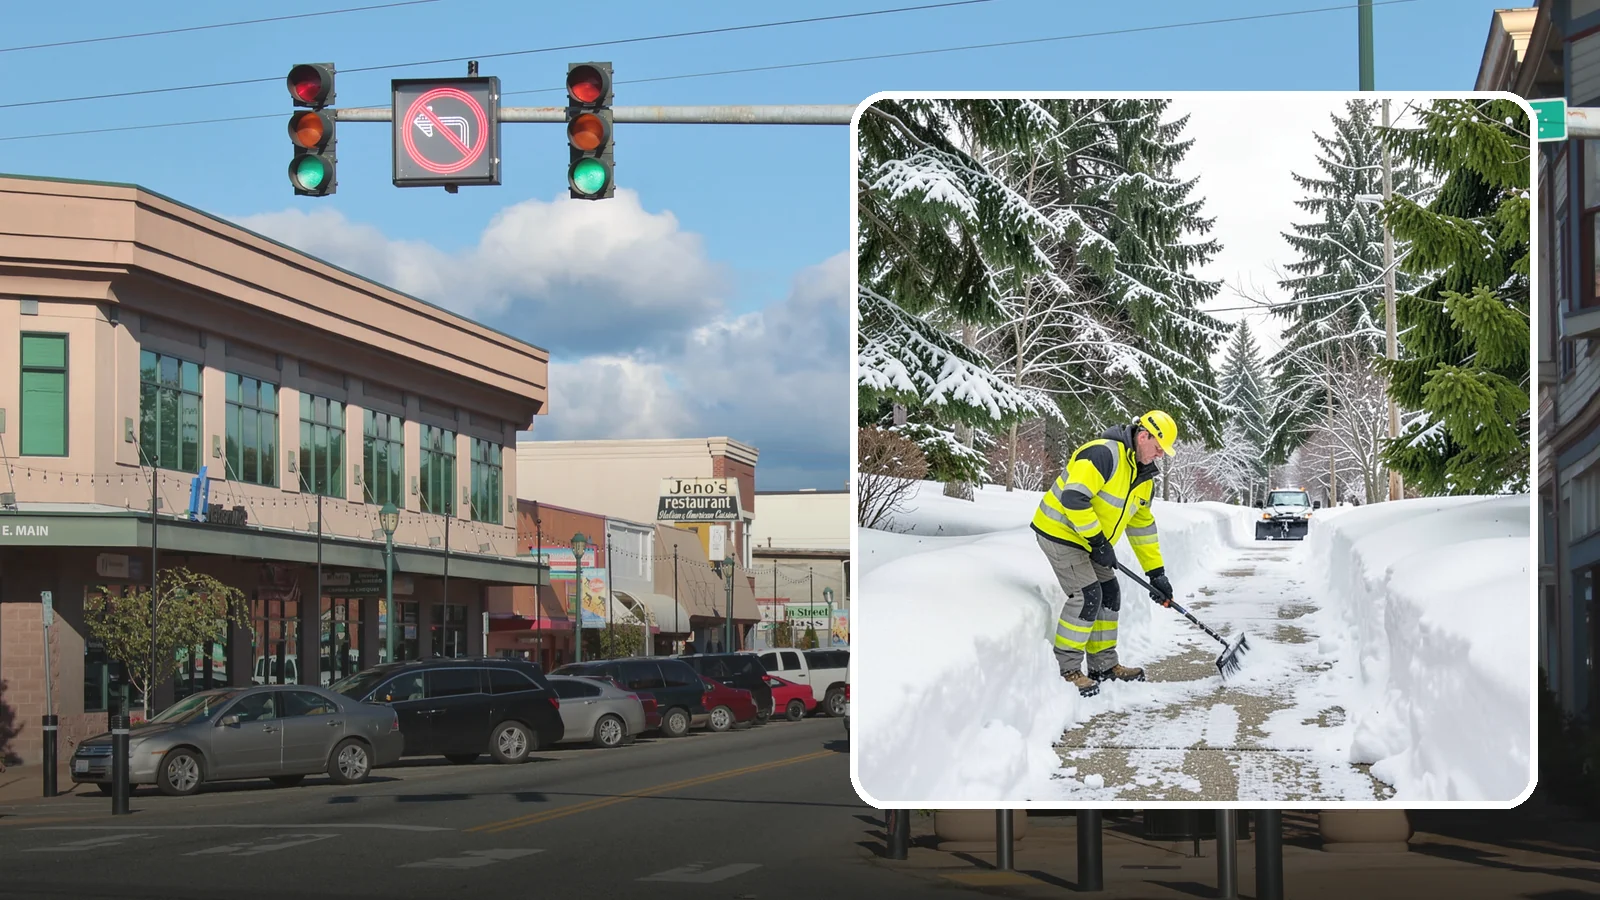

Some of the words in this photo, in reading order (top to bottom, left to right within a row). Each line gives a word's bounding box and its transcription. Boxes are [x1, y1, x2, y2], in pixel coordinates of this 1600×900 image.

[669, 480, 727, 494] Jeno's
[665, 496, 731, 509] restaurant
[658, 509, 681, 519] Italian
[686, 509, 714, 519] American
[715, 509, 738, 519] Cuisine
[2, 525, 13, 536] E.
[15, 525, 49, 536] MAIN
[797, 607, 829, 616] Street
[791, 619, 824, 627] lass
